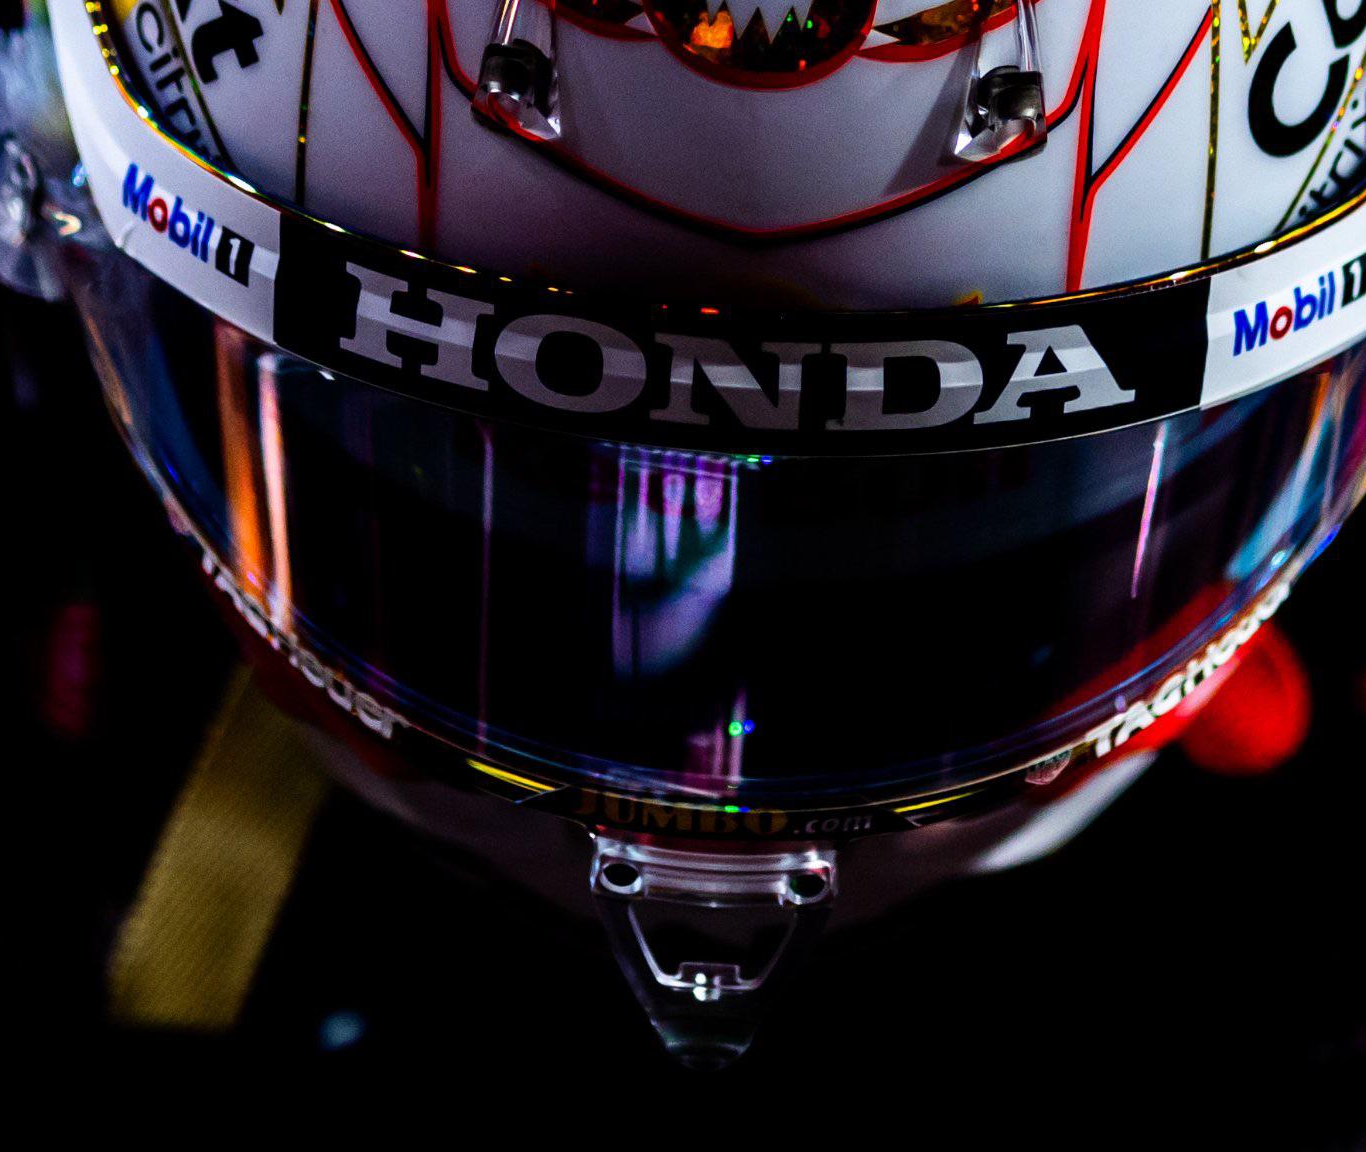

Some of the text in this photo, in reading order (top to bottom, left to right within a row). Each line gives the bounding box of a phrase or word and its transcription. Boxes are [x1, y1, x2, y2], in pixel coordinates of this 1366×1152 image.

[123, 163, 215, 263] Mobil
[339, 257, 1135, 432] HONDA
[1234, 271, 1335, 356] Mobil
